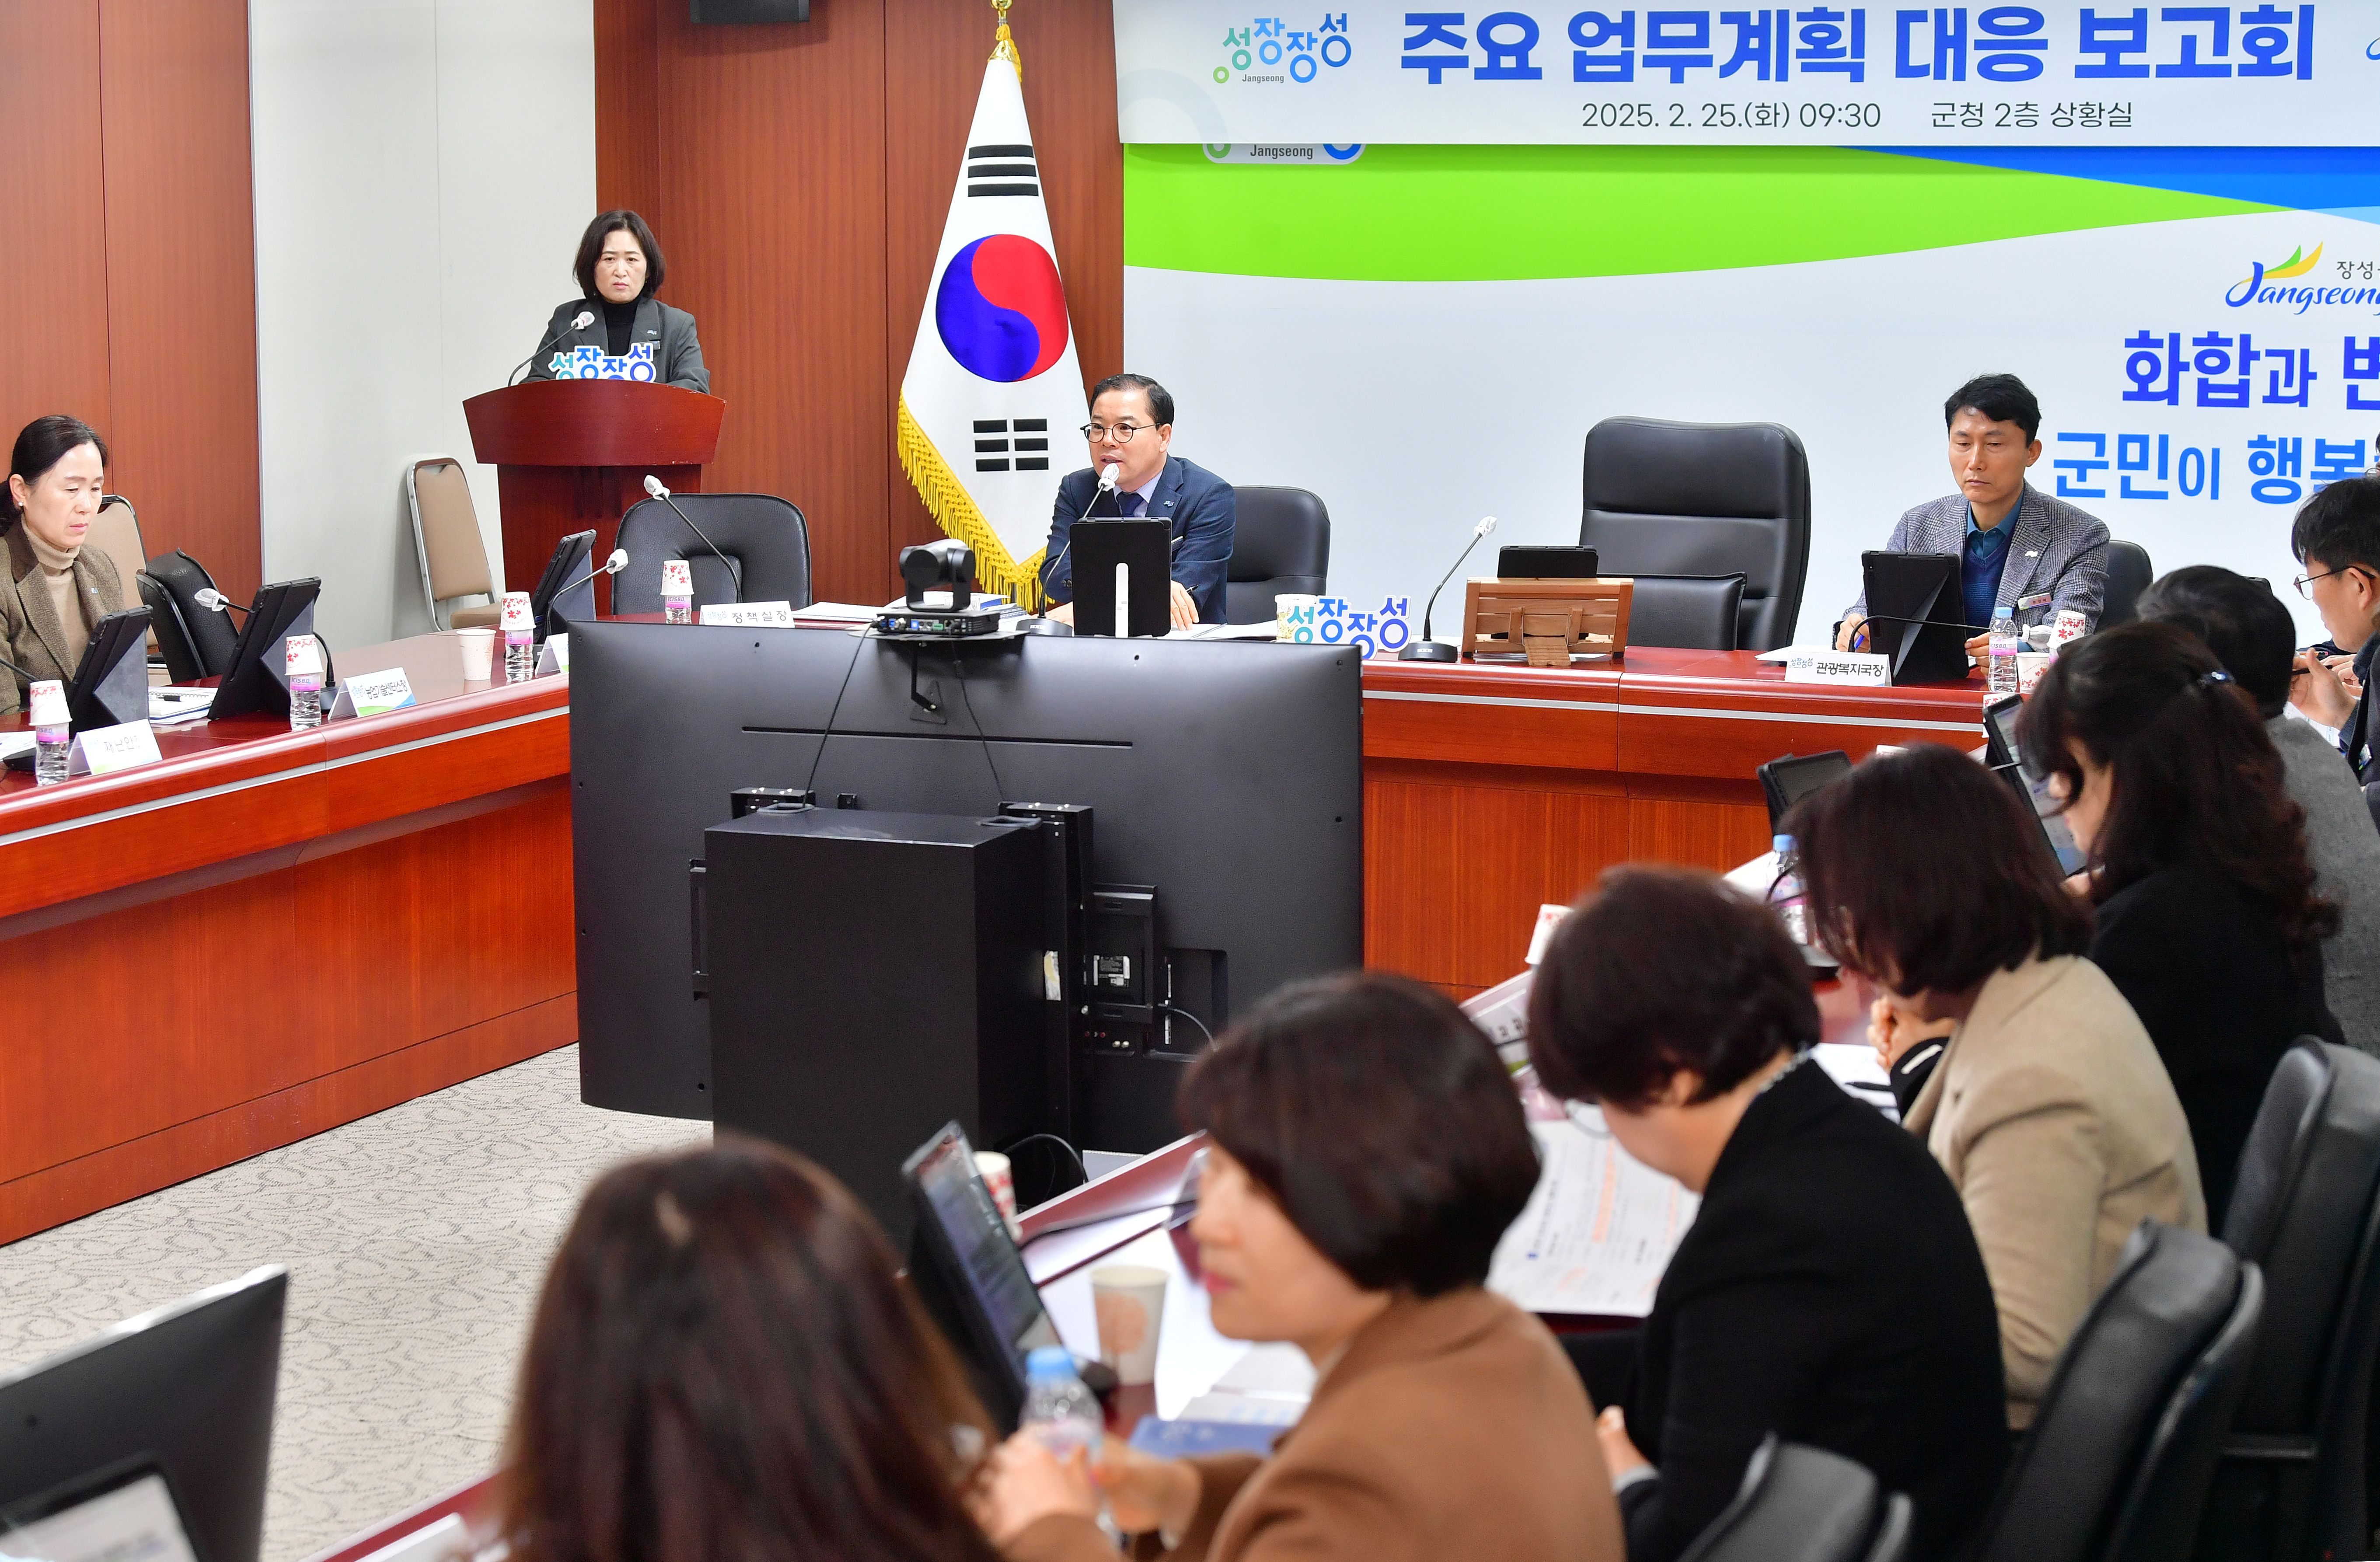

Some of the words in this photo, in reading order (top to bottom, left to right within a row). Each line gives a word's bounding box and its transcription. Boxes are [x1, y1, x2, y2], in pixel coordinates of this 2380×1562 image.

[1222, 13, 1352, 83] 성장장성
[1401, 11, 1543, 85] 주요
[1567, 7, 1866, 84] 업무계획
[1895, 6, 2049, 83] 대응
[2074, 3, 2315, 80] 보고회
[1242, 74, 1284, 84] Jangseong
[1583, 103, 1659, 127] 2025.
[1669, 103, 1692, 127] 2.
[1702, 101, 1790, 128] 25.(화)
[1800, 103, 1881, 128] 09:30
[1932, 102, 1983, 128] 군청
[1995, 102, 2039, 128] 2층
[2051, 102, 2132, 128] 상황실
[1250, 144, 1313, 160] Jangseong
[2337, 261, 2380, 280] 장성
[551, 345, 654, 382] 성장장성
[2122, 329, 2317, 408] 화합과
[2053, 432, 2221, 501] 군민이
[2247, 434, 2380, 505] 행복
[1287, 598, 1409, 659] 성장장성
[1816, 662, 1884, 677] 관광복지국장
